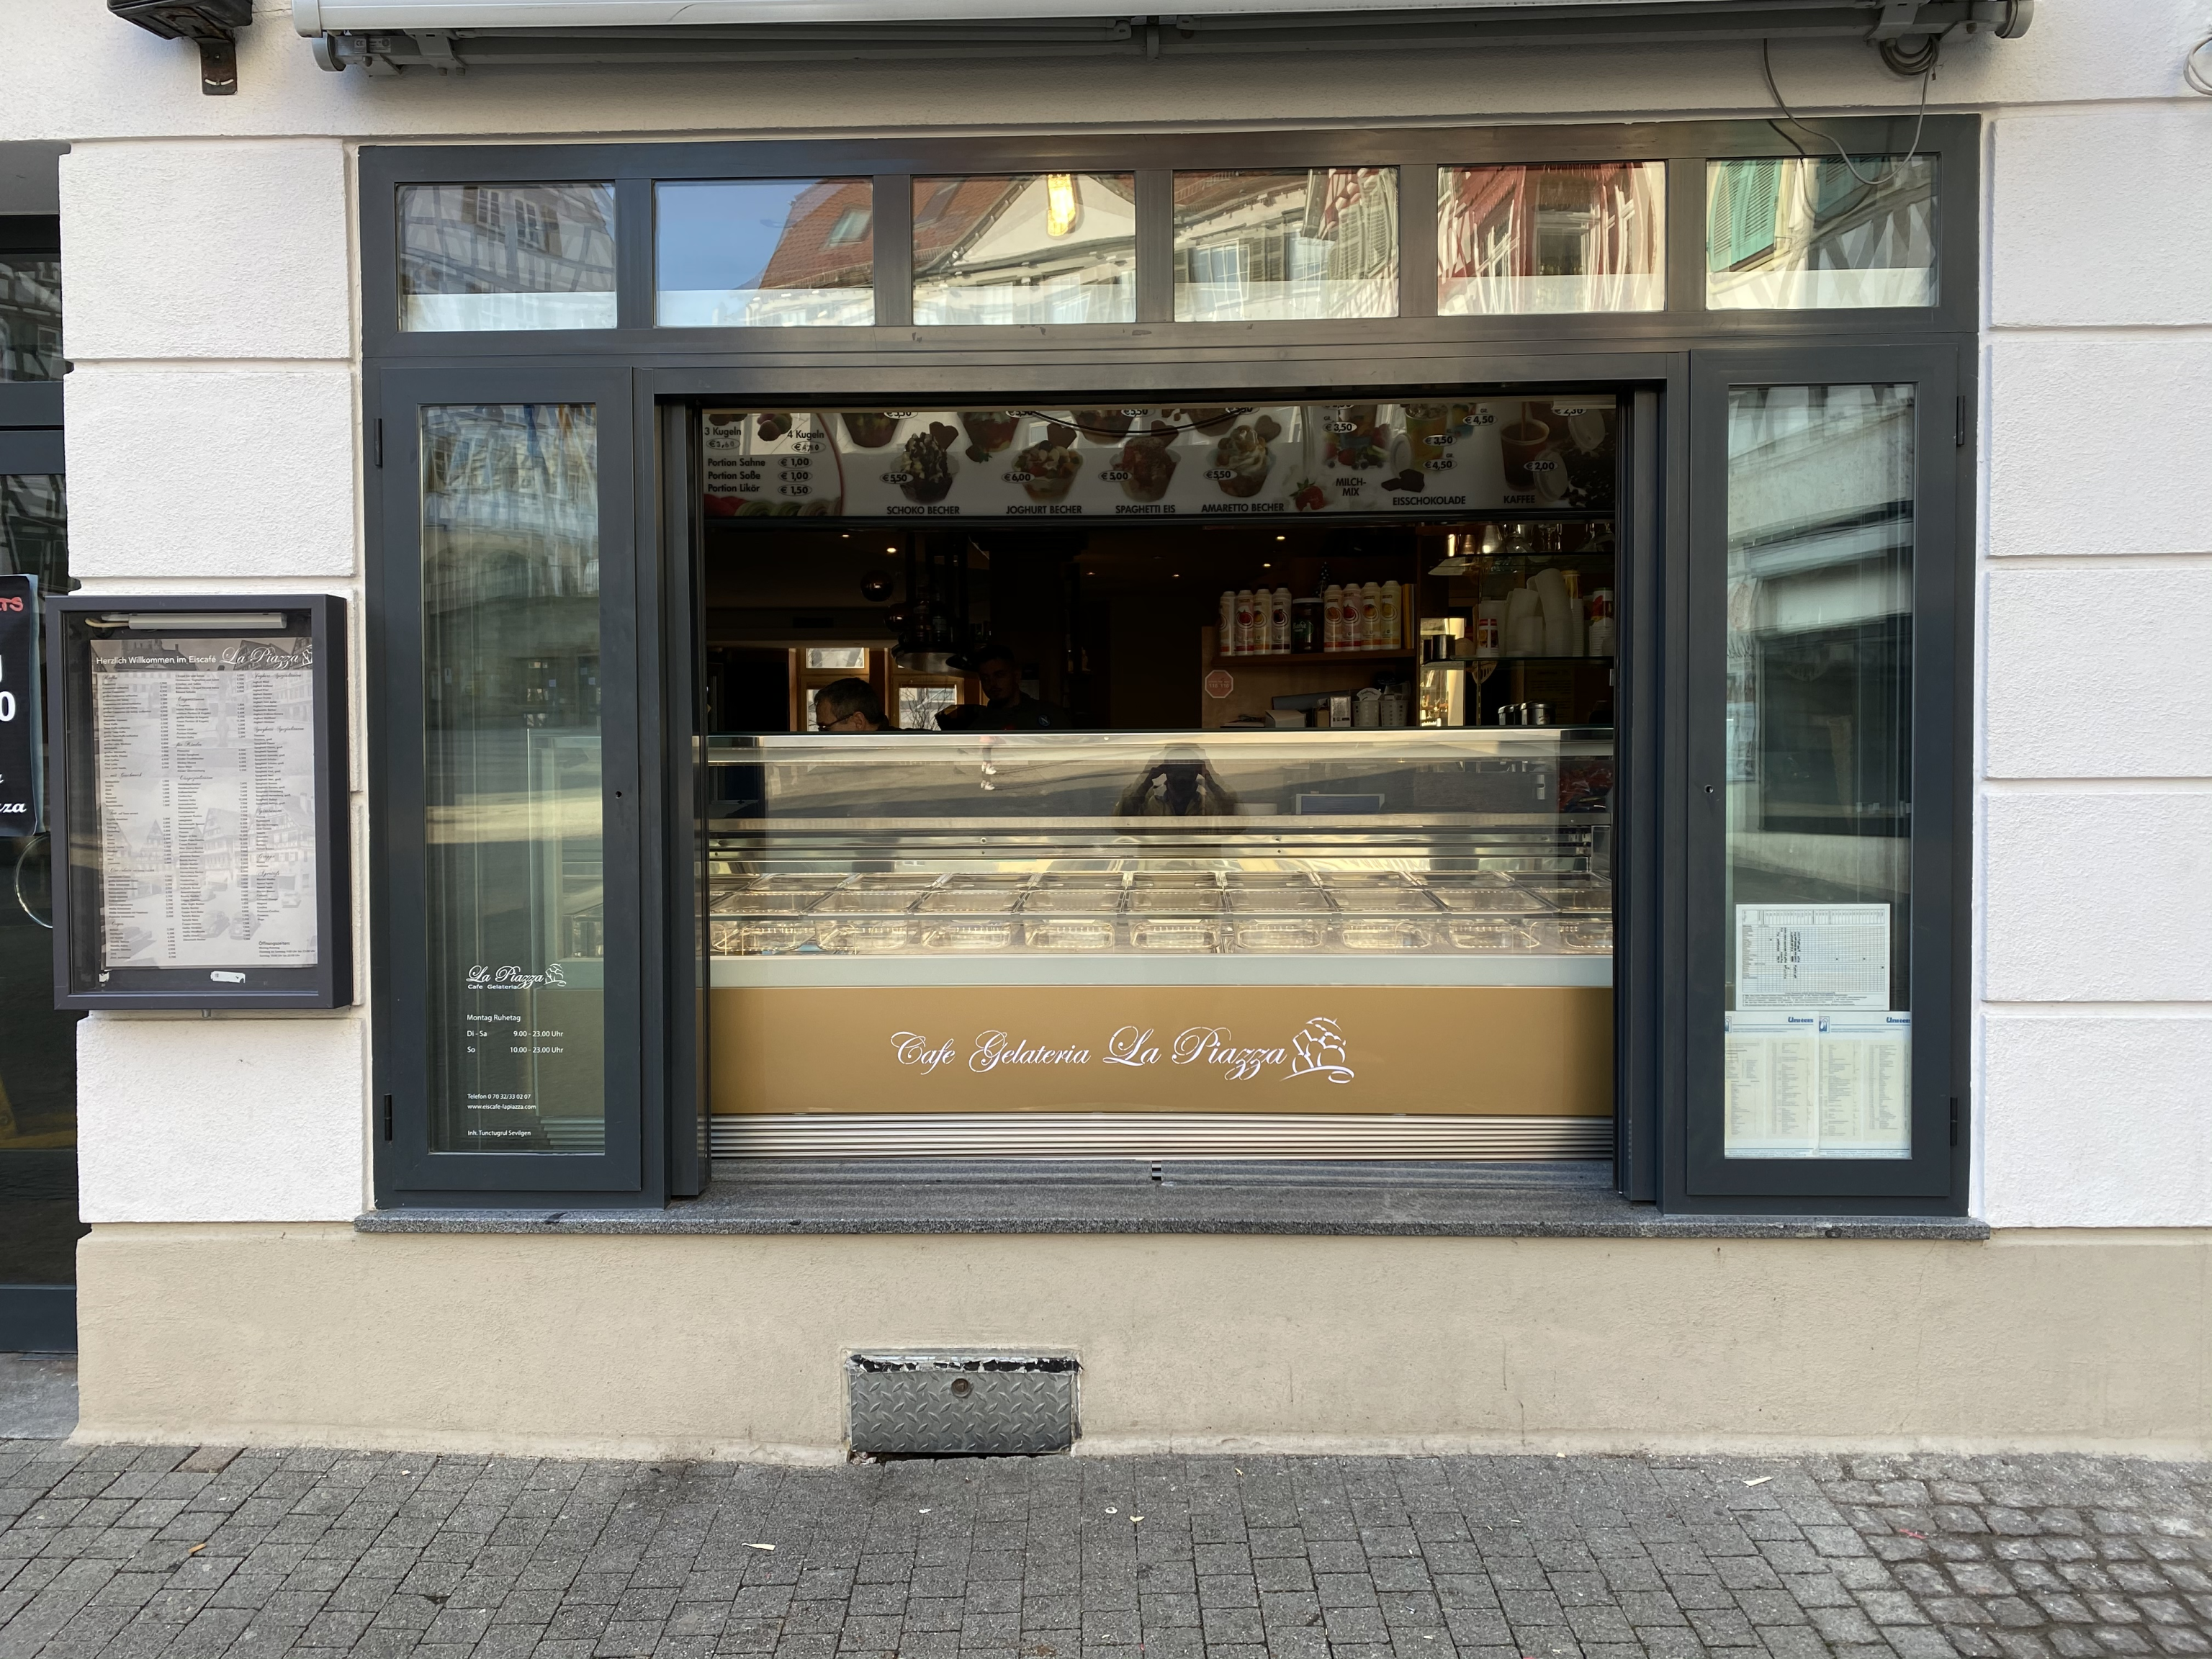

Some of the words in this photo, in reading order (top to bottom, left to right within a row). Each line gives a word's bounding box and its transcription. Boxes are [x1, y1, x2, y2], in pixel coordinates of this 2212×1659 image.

[713, 428, 742, 438] Kugeln
[796, 430, 824, 441] Kugeln
[708, 458, 737, 467] Portion
[739, 458, 765, 467] Sahne
[739, 471, 760, 480] Soße
[708, 484, 737, 493] Portion
[739, 483, 760, 493] Likör
[1393, 497, 1466, 505] EISSCHOKOLADE
[1503, 495, 1535, 504] KAFFEE
[886, 505, 925, 515] SCHOKO
[927, 505, 960, 515] BECHER
[1006, 505, 1048, 515] JOGHURT
[1050, 505, 1082, 515] BECHER
[1115, 505, 1161, 514] SPAGHETTI
[1163, 505, 1176, 514] EIS
[1202, 504, 1249, 513] AMARETTO
[1251, 503, 1284, 512] BECHER
[96, 656, 127, 665] Herzlich
[128, 655, 175, 665] Willkommen
[189, 655, 216, 663] Eiscafé
[220, 647, 246, 665] La
[248, 647, 300, 670] Piazza
[466, 965, 491, 984] La
[495, 966, 544, 989] Piazza
[467, 1014, 493, 1022] Montag
[493, 1014, 521, 1022] Ruhetag
[890, 1031, 956, 1075] Cafe
[968, 1030, 1092, 1075] Gelateria
[1102, 1025, 1161, 1068] La
[1172, 1025, 1287, 1081] Piazza
